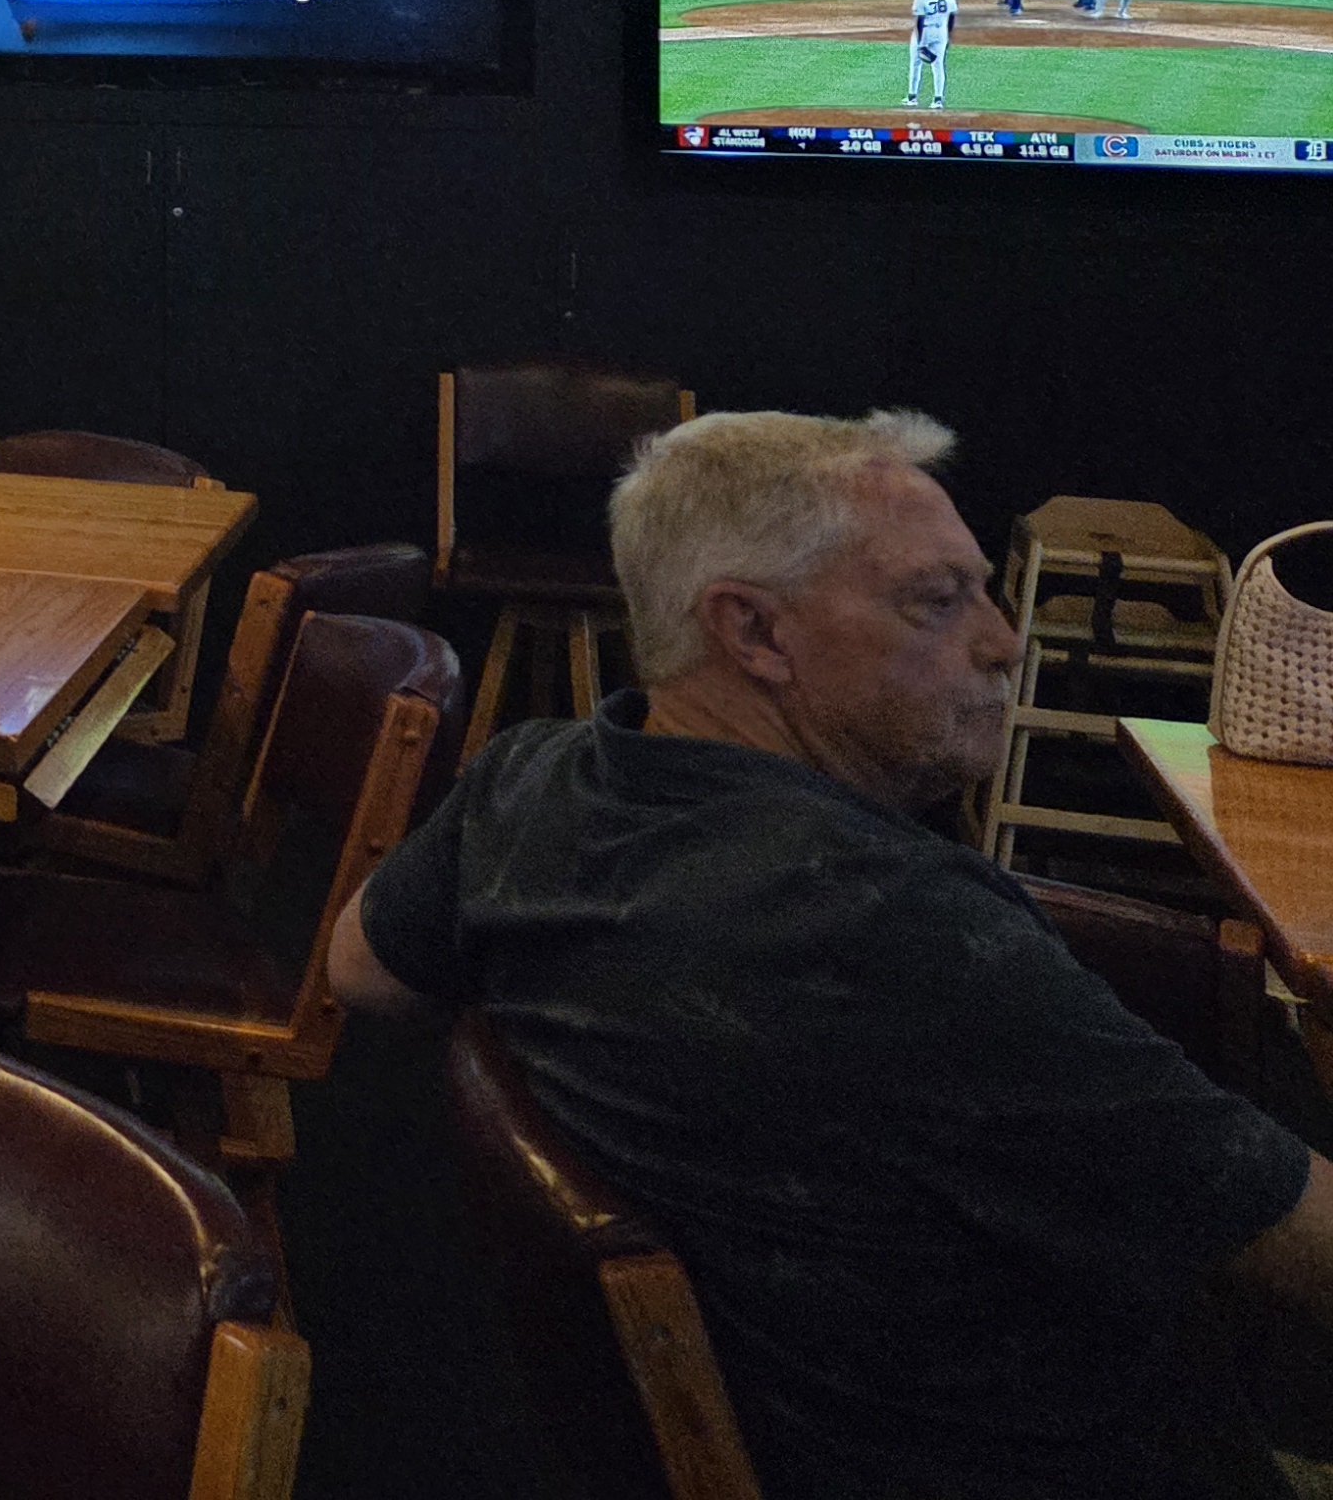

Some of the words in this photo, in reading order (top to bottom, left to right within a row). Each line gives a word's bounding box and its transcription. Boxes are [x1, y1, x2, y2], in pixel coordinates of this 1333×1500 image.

[924, 0, 948, 16] 38
[731, 128, 760, 138] WEST
[848, 128, 874, 140] SEA
[908, 130, 934, 141] LAA
[968, 131, 995, 143] TEX
[1029, 132, 1057, 145] ATH
[1174, 138, 1204, 149] CUBS
[1217, 140, 1257, 150] TIGERS
[1154, 149, 1203, 158] SATURDAY
[1205, 149, 1220, 158] ON
